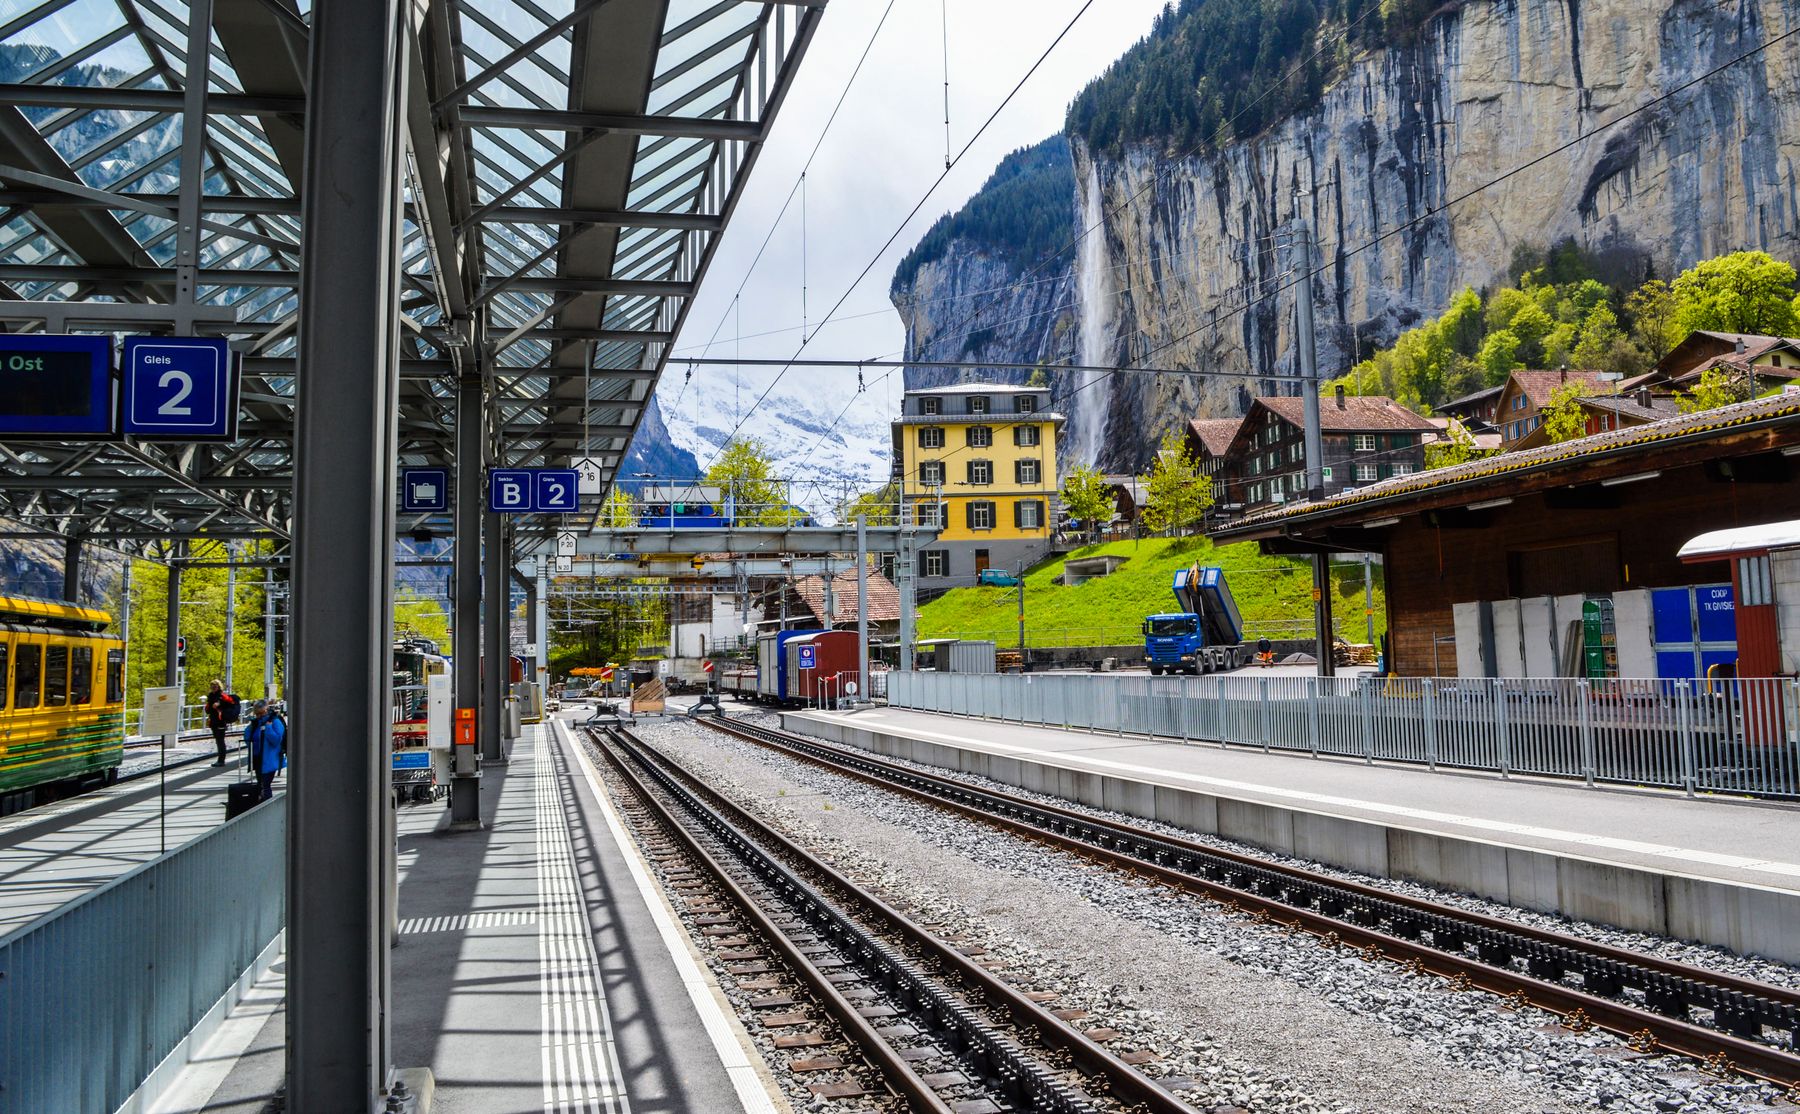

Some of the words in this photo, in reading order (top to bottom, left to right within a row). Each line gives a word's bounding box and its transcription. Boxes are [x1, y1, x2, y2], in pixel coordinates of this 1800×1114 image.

[9, 355, 44, 371] Ost
[144, 355, 171, 365] Gleis
[158, 370, 193, 416] 2
[584, 462, 590, 471] A
[587, 472, 595, 481] 16
[503, 483, 521, 505] B
[549, 483, 565, 505] 2
[1711, 589, 1728, 599] COOP
